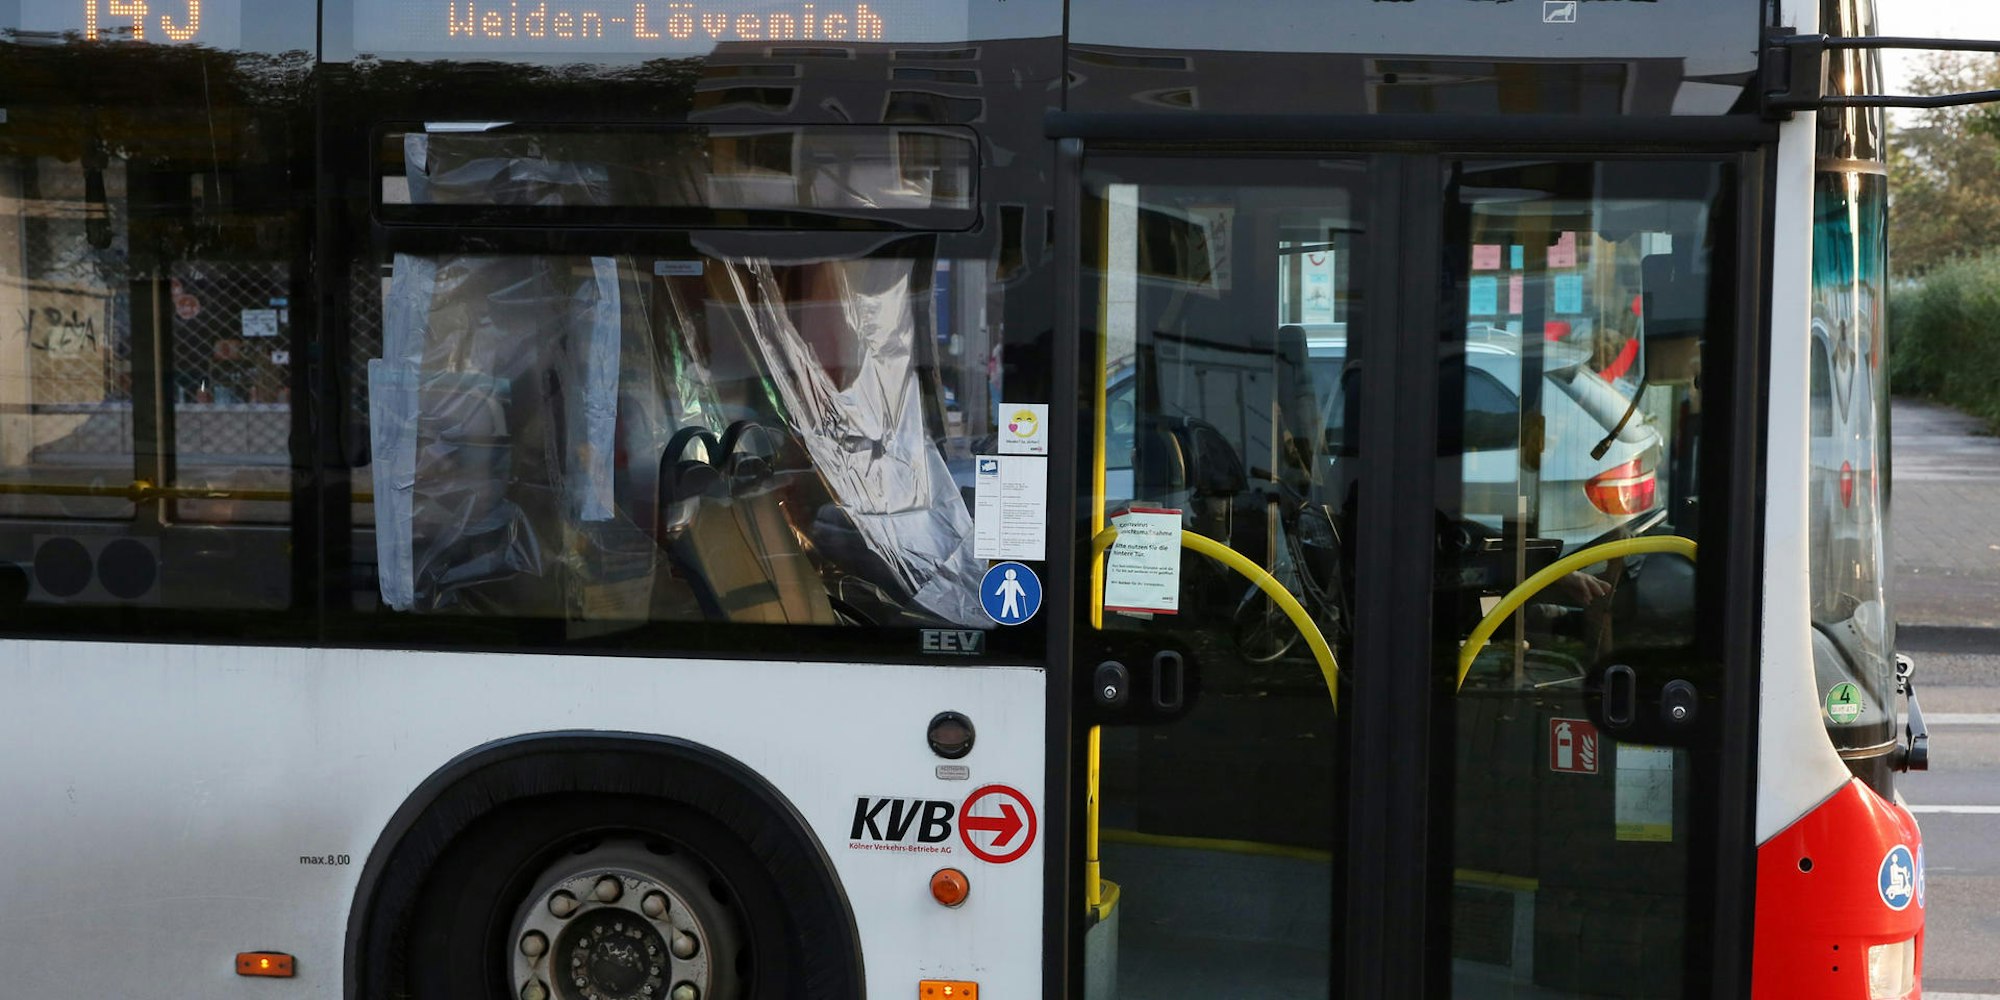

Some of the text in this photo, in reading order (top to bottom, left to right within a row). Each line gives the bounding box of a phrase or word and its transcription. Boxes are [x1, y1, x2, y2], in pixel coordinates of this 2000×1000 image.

[448, 2, 882, 39] Weiden-Lövenich
[923, 631, 981, 650] EEV
[1840, 685, 1850, 704] 4
[850, 797, 955, 843] KVB
[874, 843, 939, 853] Verkehrs-Betriebe
[940, 846, 952, 854] AG
[300, 854, 350, 866] max.8,00
